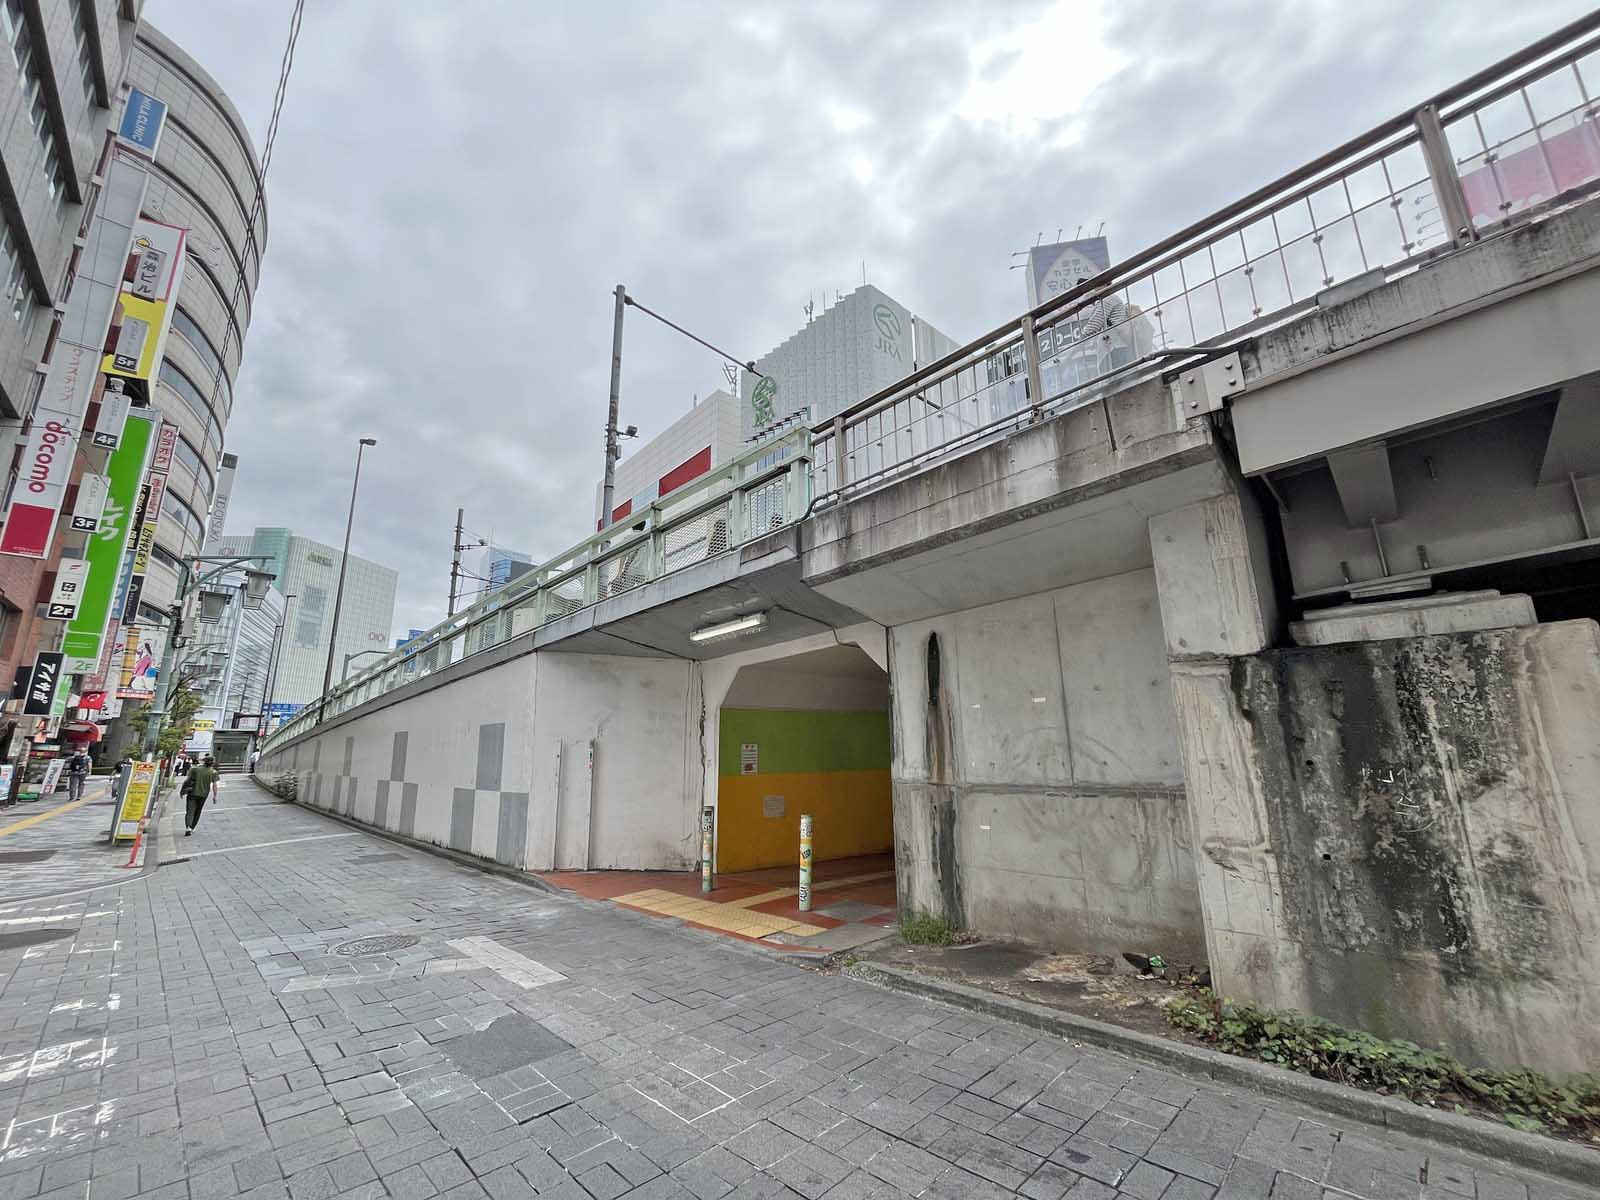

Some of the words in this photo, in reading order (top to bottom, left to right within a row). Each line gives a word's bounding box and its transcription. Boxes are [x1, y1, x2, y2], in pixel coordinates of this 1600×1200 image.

[116, 355, 135, 369] 5F
[96, 434, 117, 445] 4F
[28, 421, 72, 493] docomo
[74, 517, 96, 530] 3F
[51, 605, 73, 616] 2F
[74, 660, 93, 671] 2F
[32, 662, 57, 705] アイサポ
